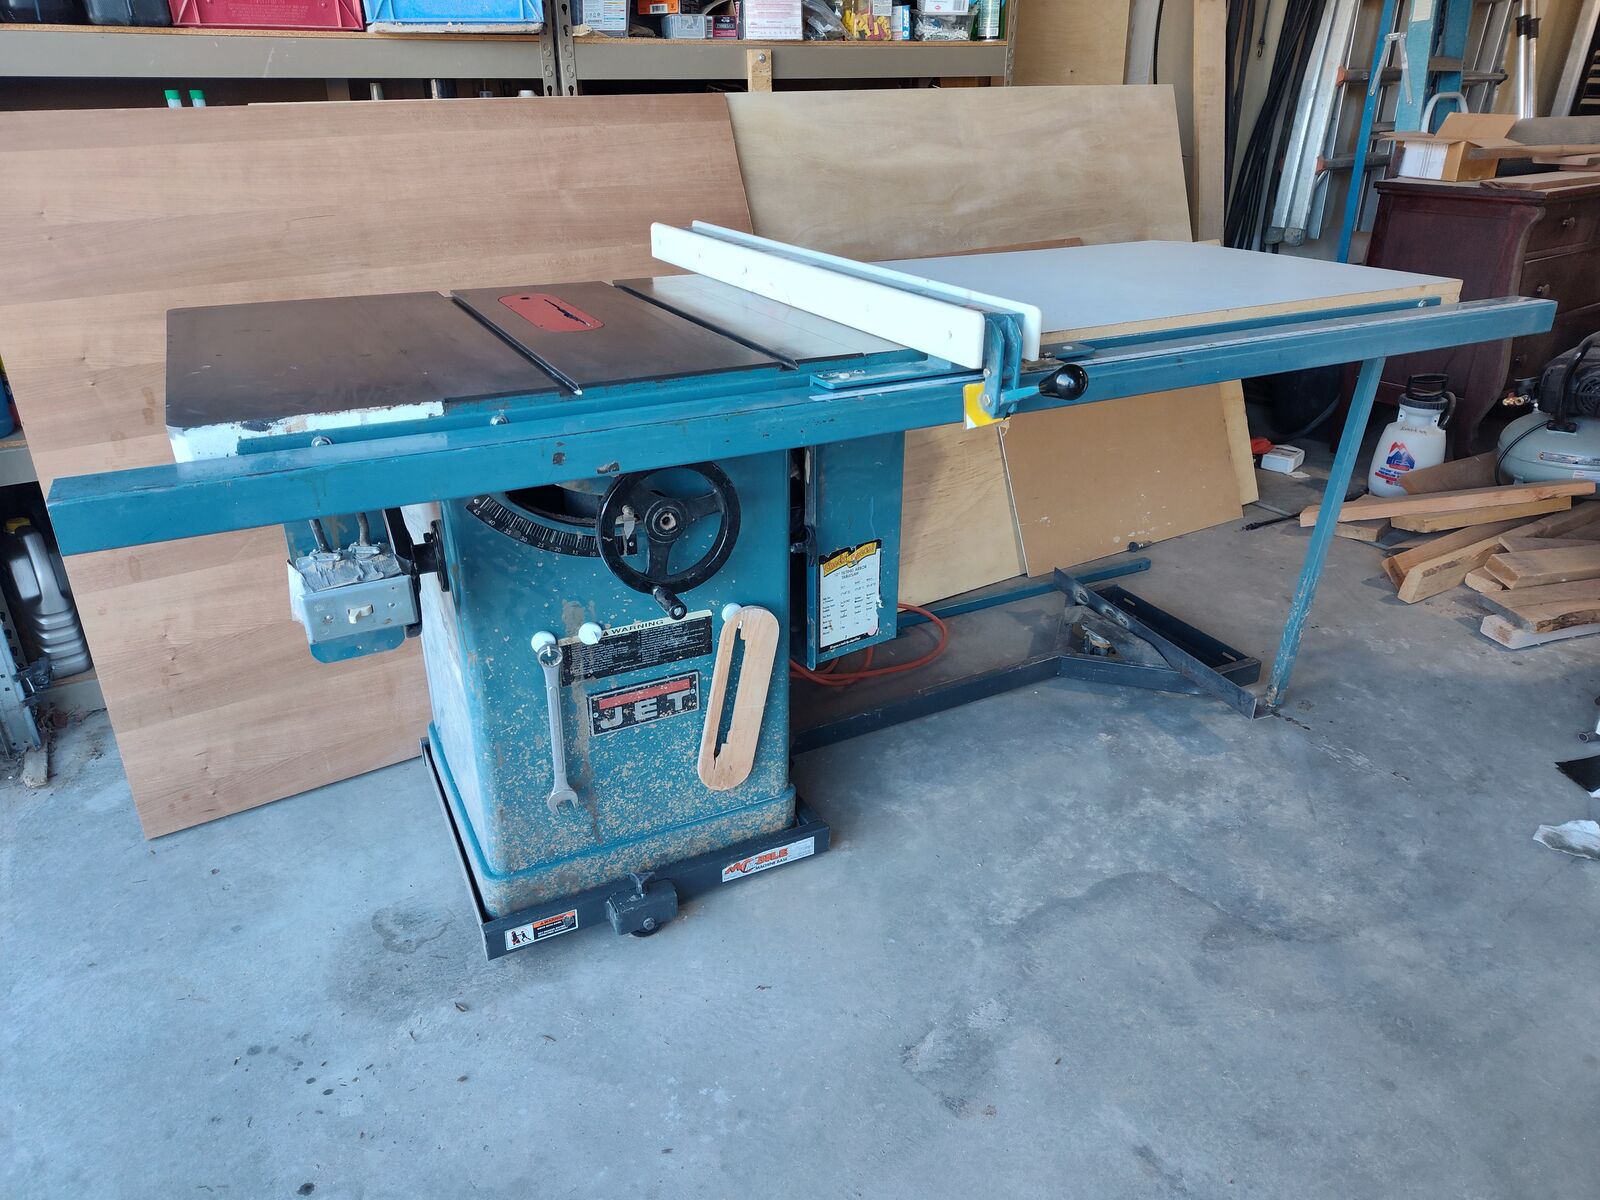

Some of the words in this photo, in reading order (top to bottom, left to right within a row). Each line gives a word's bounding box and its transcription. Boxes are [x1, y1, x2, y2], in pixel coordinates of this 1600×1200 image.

[472, 508, 481, 516] 45
[611, 620, 664, 634] WARNING
[600, 691, 691, 729] JET
